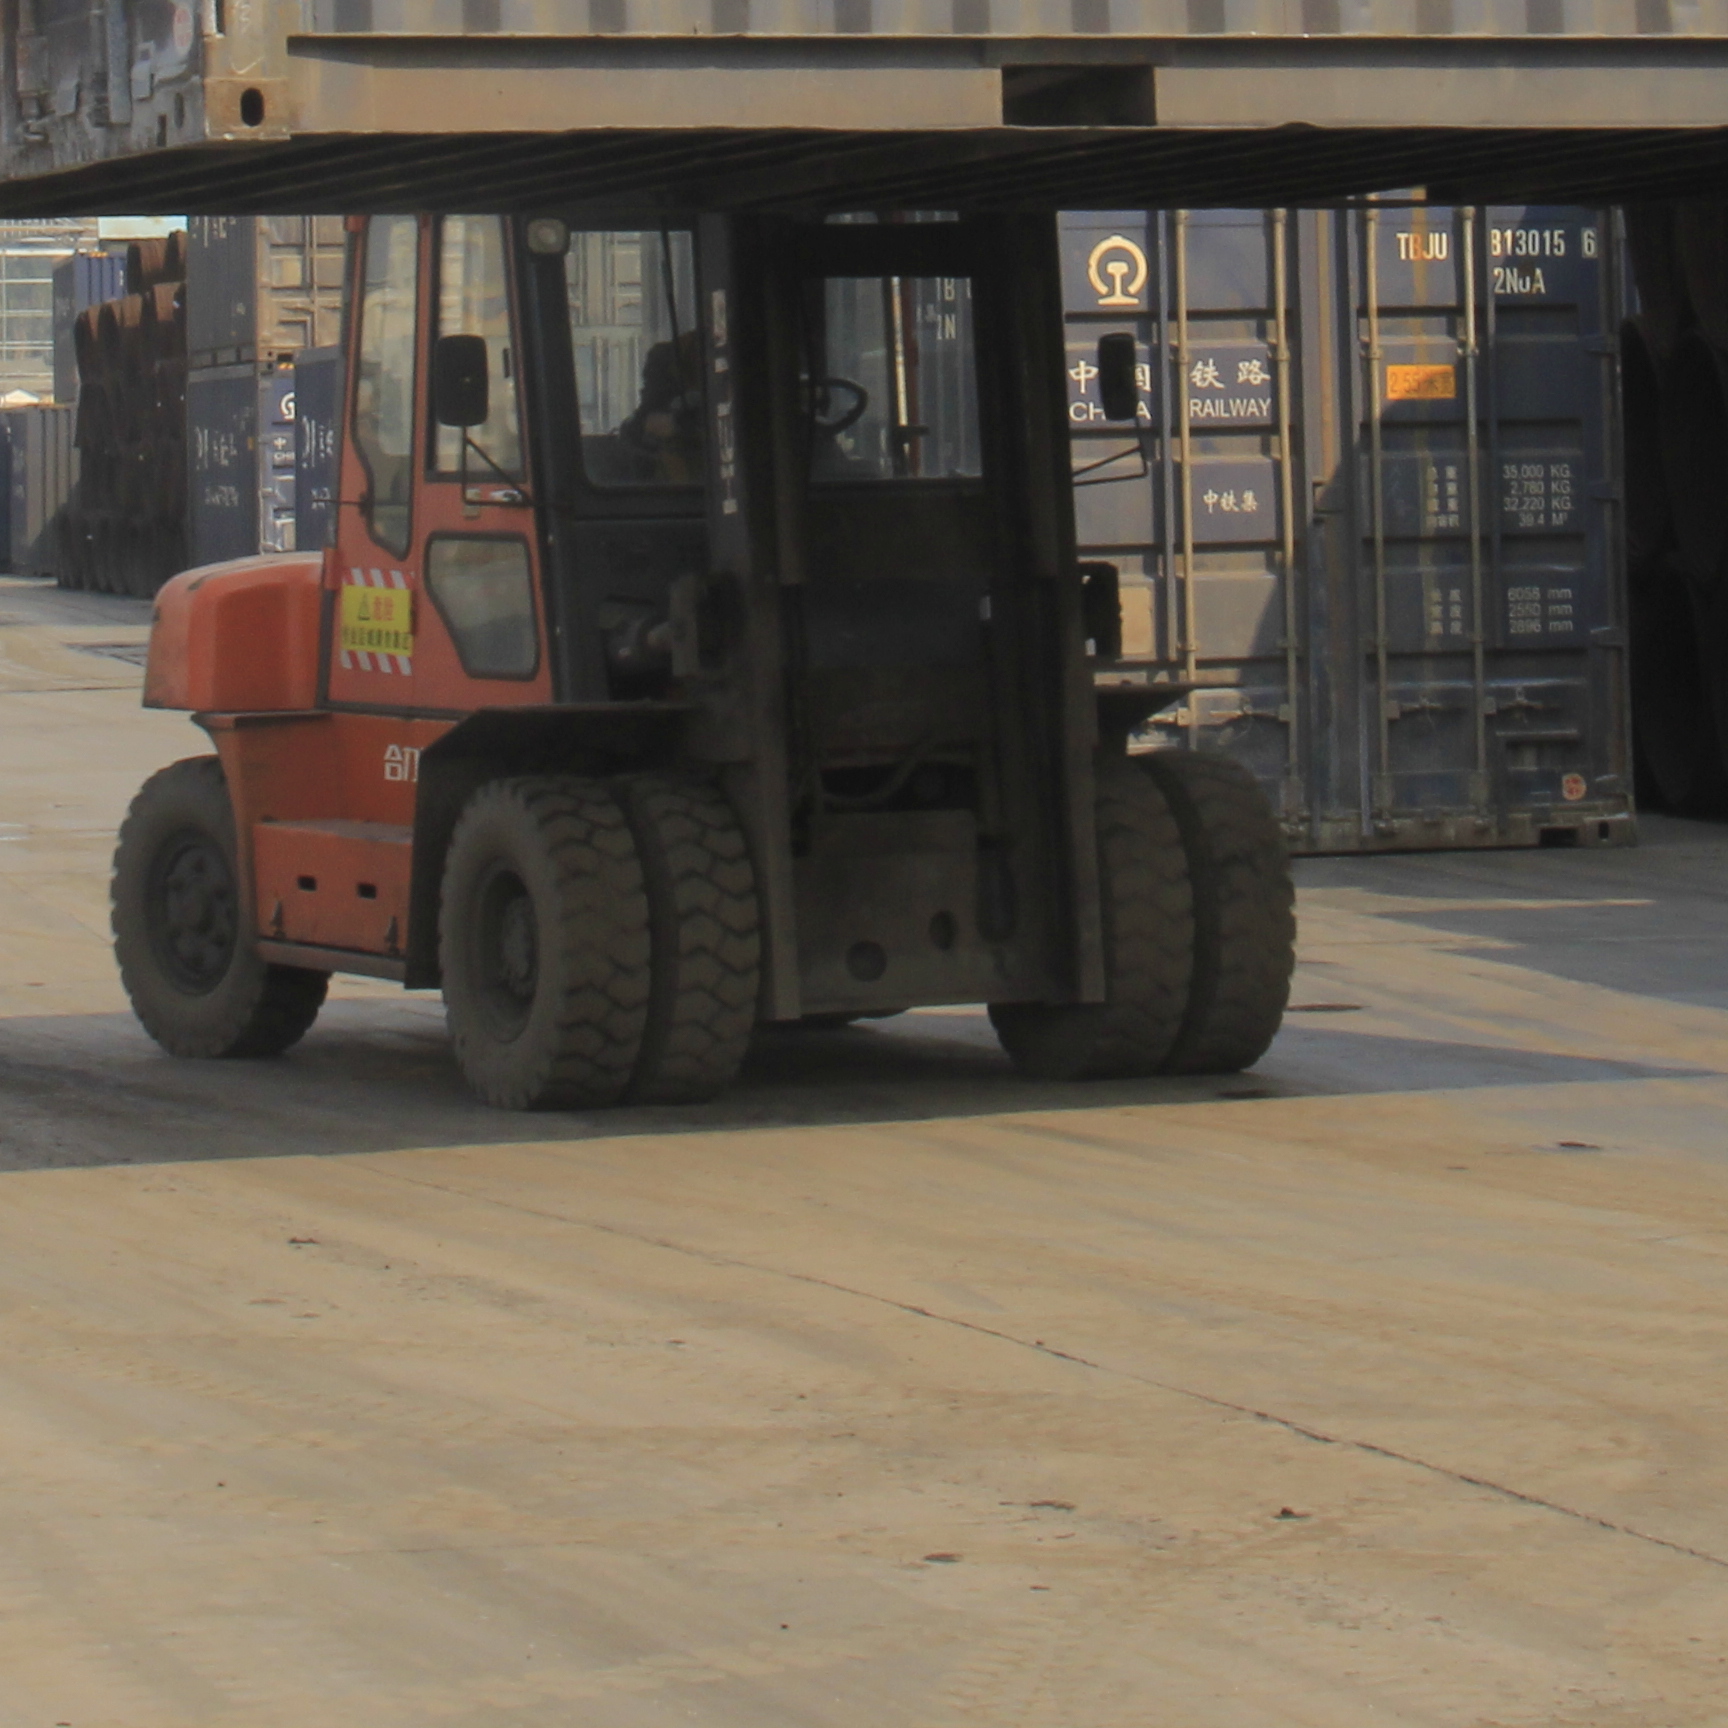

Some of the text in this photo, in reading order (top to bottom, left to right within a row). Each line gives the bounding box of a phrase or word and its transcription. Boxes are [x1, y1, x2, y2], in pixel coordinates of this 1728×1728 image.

[1396, 231, 1449, 262] TBJU
[1582, 228, 1597, 258] 6
[1069, 397, 1272, 422] CHA RAILWAY
[1202, 488, 1259, 515] 中铁集
